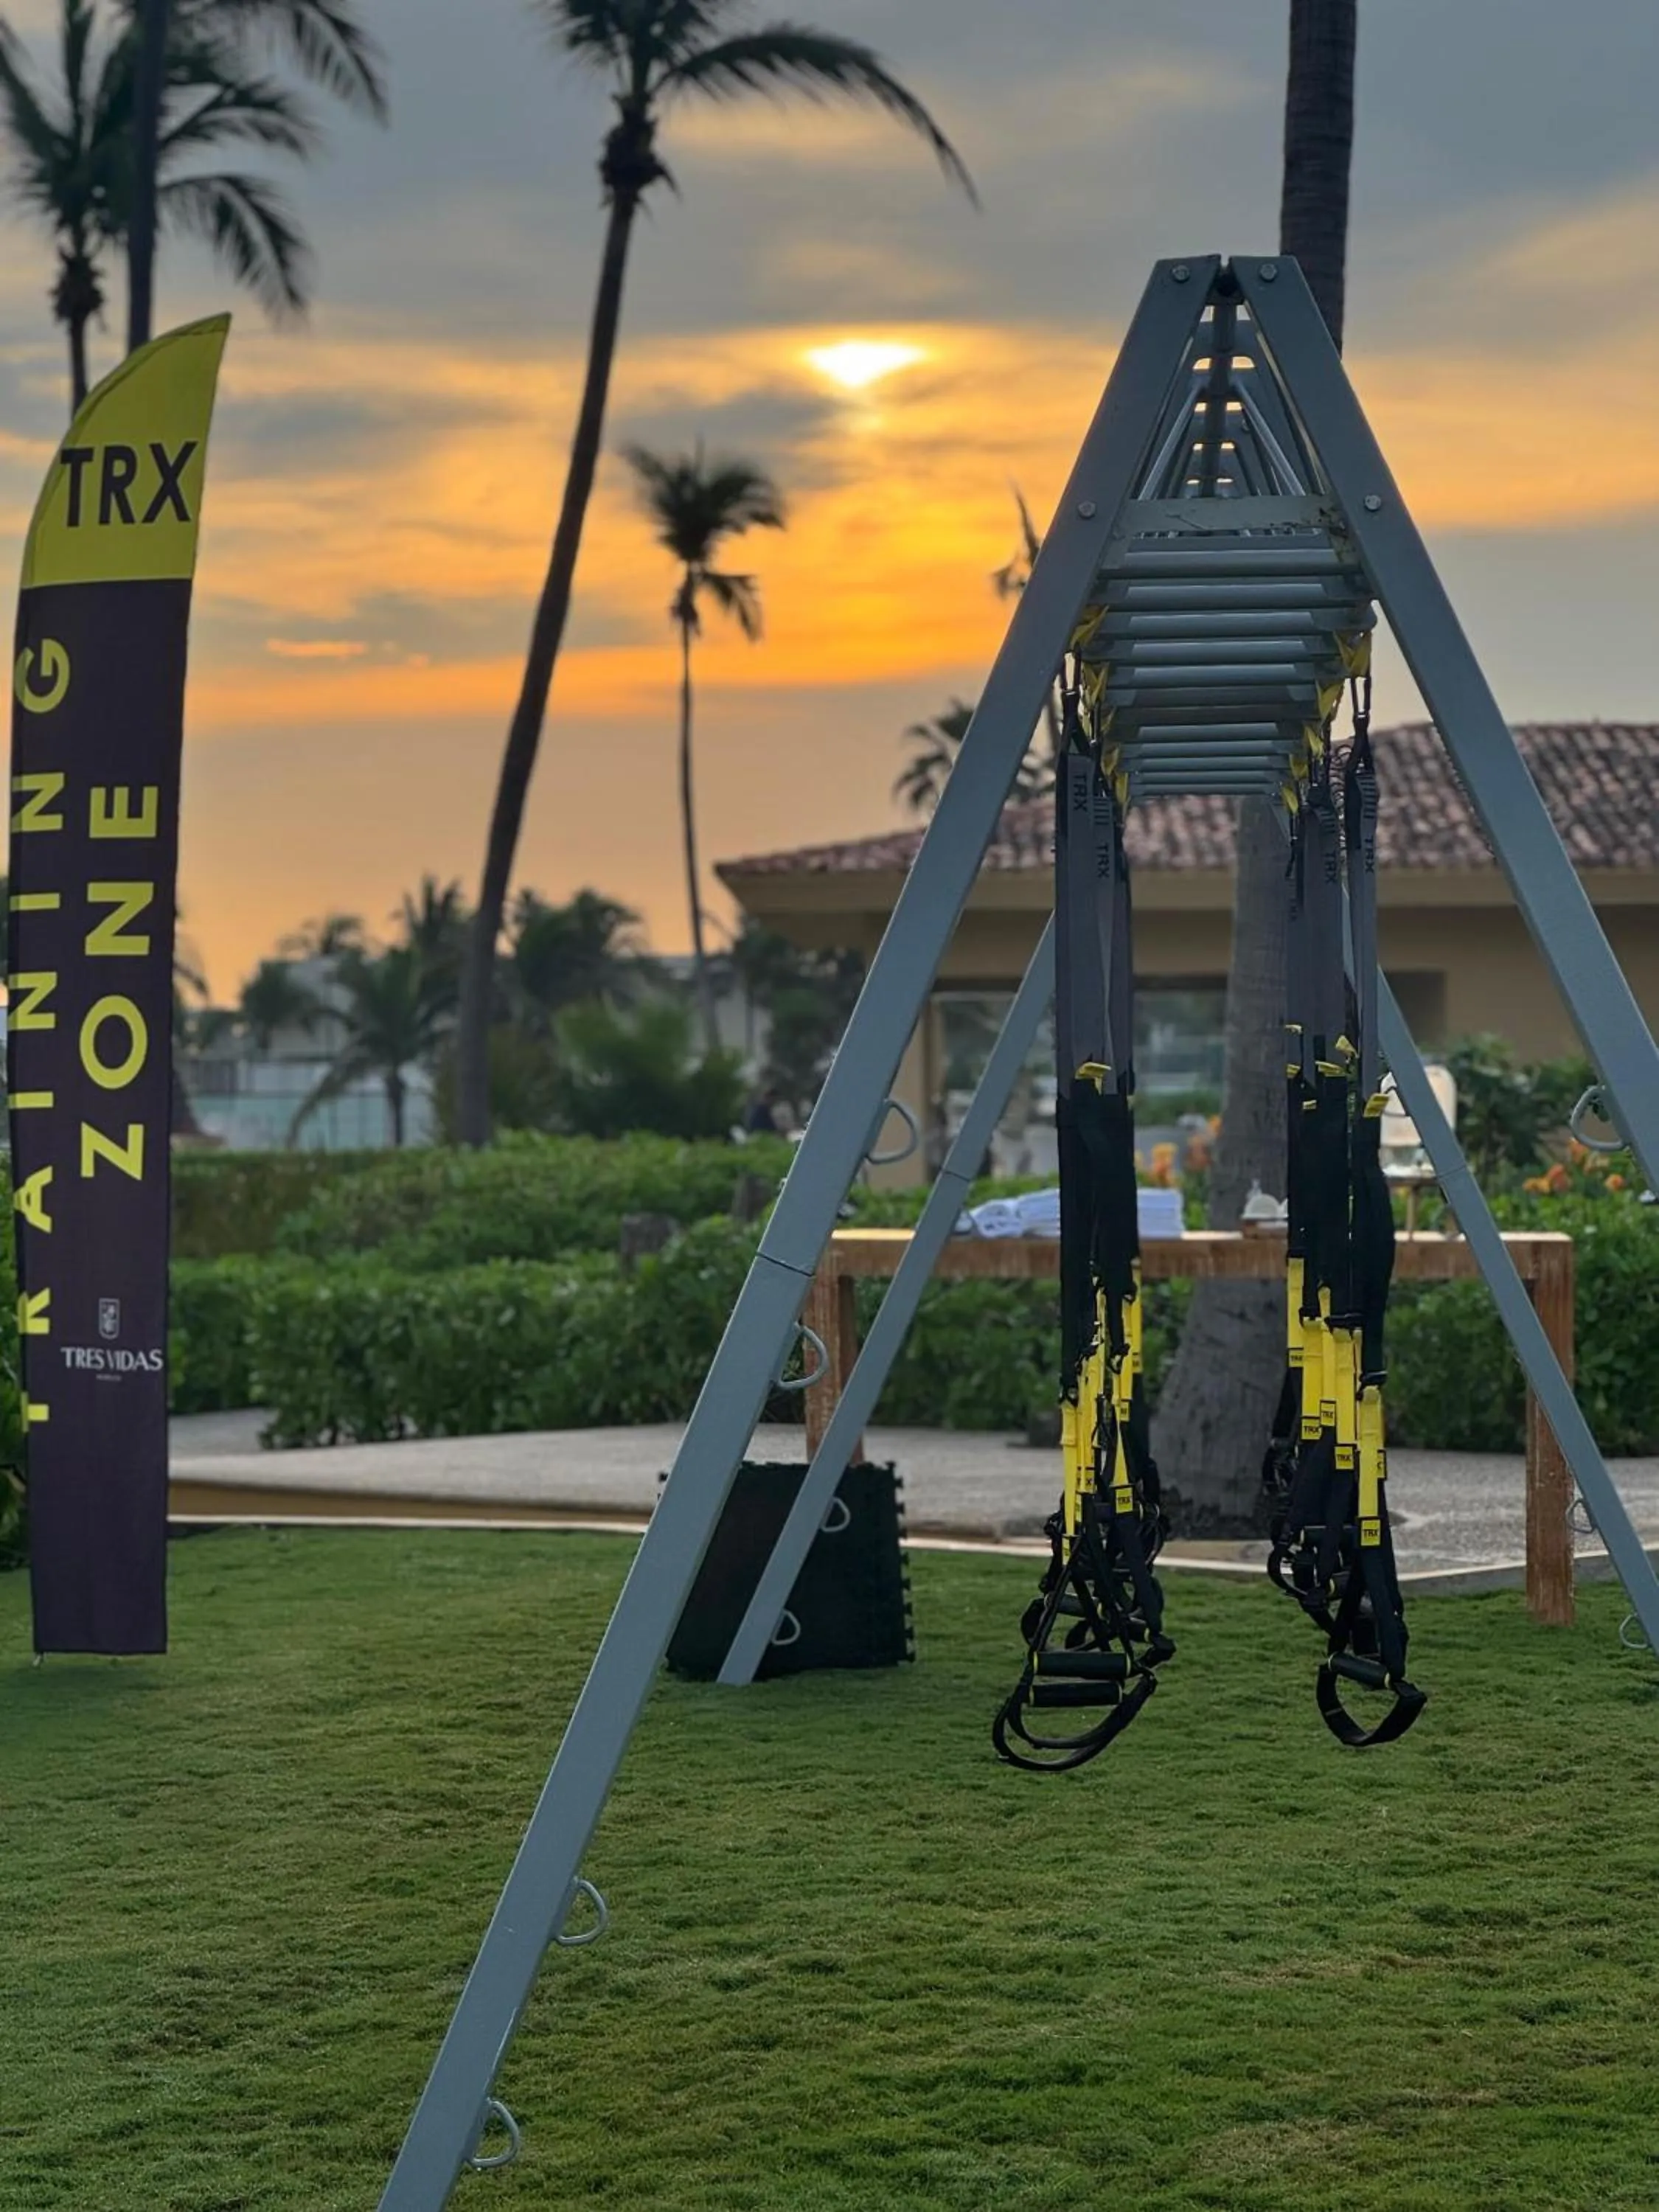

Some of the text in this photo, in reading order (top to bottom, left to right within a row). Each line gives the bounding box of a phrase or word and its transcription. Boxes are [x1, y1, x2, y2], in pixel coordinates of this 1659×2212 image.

[60, 441, 198, 527] TRX
[1073, 775, 1088, 812] TRX
[1096, 844, 1110, 879] TRX
[1324, 850, 1338, 885] TRX
[1361, 835, 1375, 874] TRX
[79, 786, 159, 1180] ZONE
[7, 639, 70, 1433] TRAINING
[60, 1346, 164, 1371] TRES VIDAS
[1363, 1528, 1378, 1537] TRX
